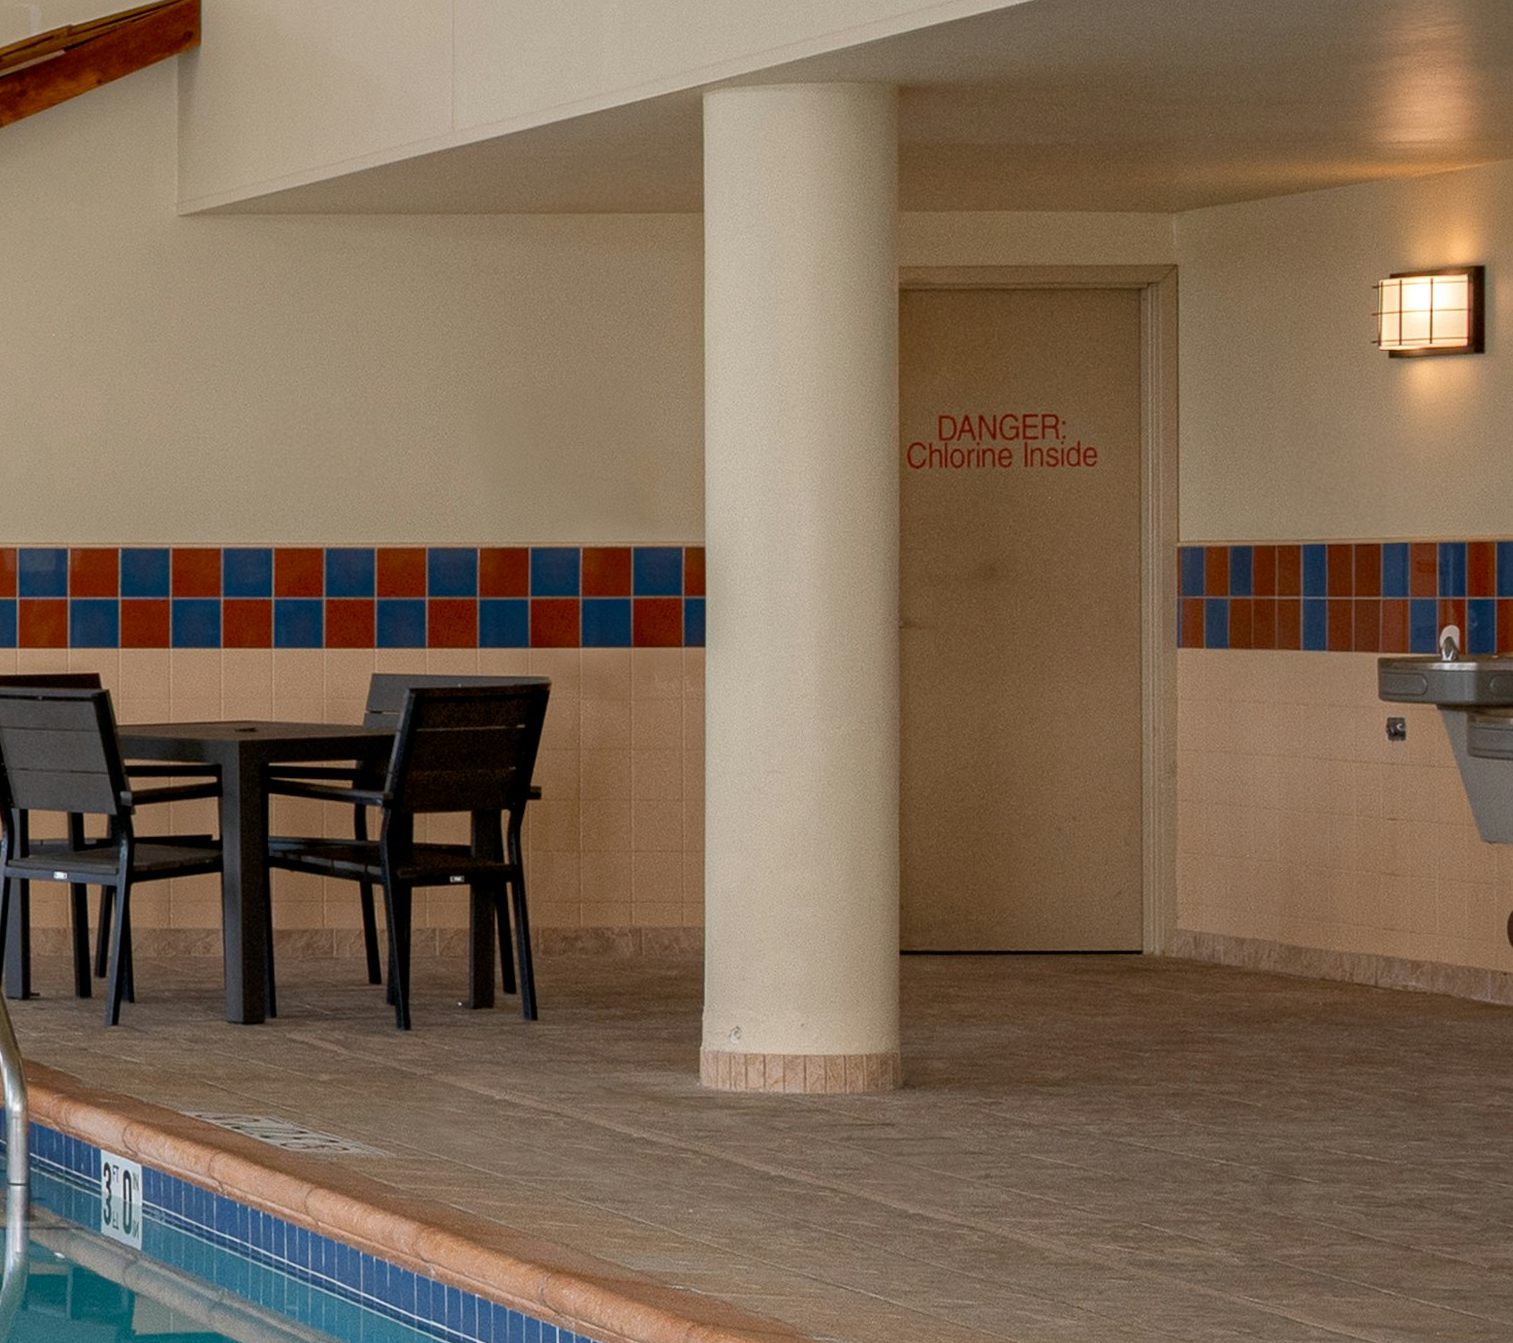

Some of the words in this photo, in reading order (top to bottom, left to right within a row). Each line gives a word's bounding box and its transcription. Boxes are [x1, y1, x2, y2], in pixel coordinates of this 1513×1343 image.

[938, 414, 1066, 441] DANGER:
[907, 441, 1012, 469] Chlorine
[1023, 440, 1098, 468] Inside
